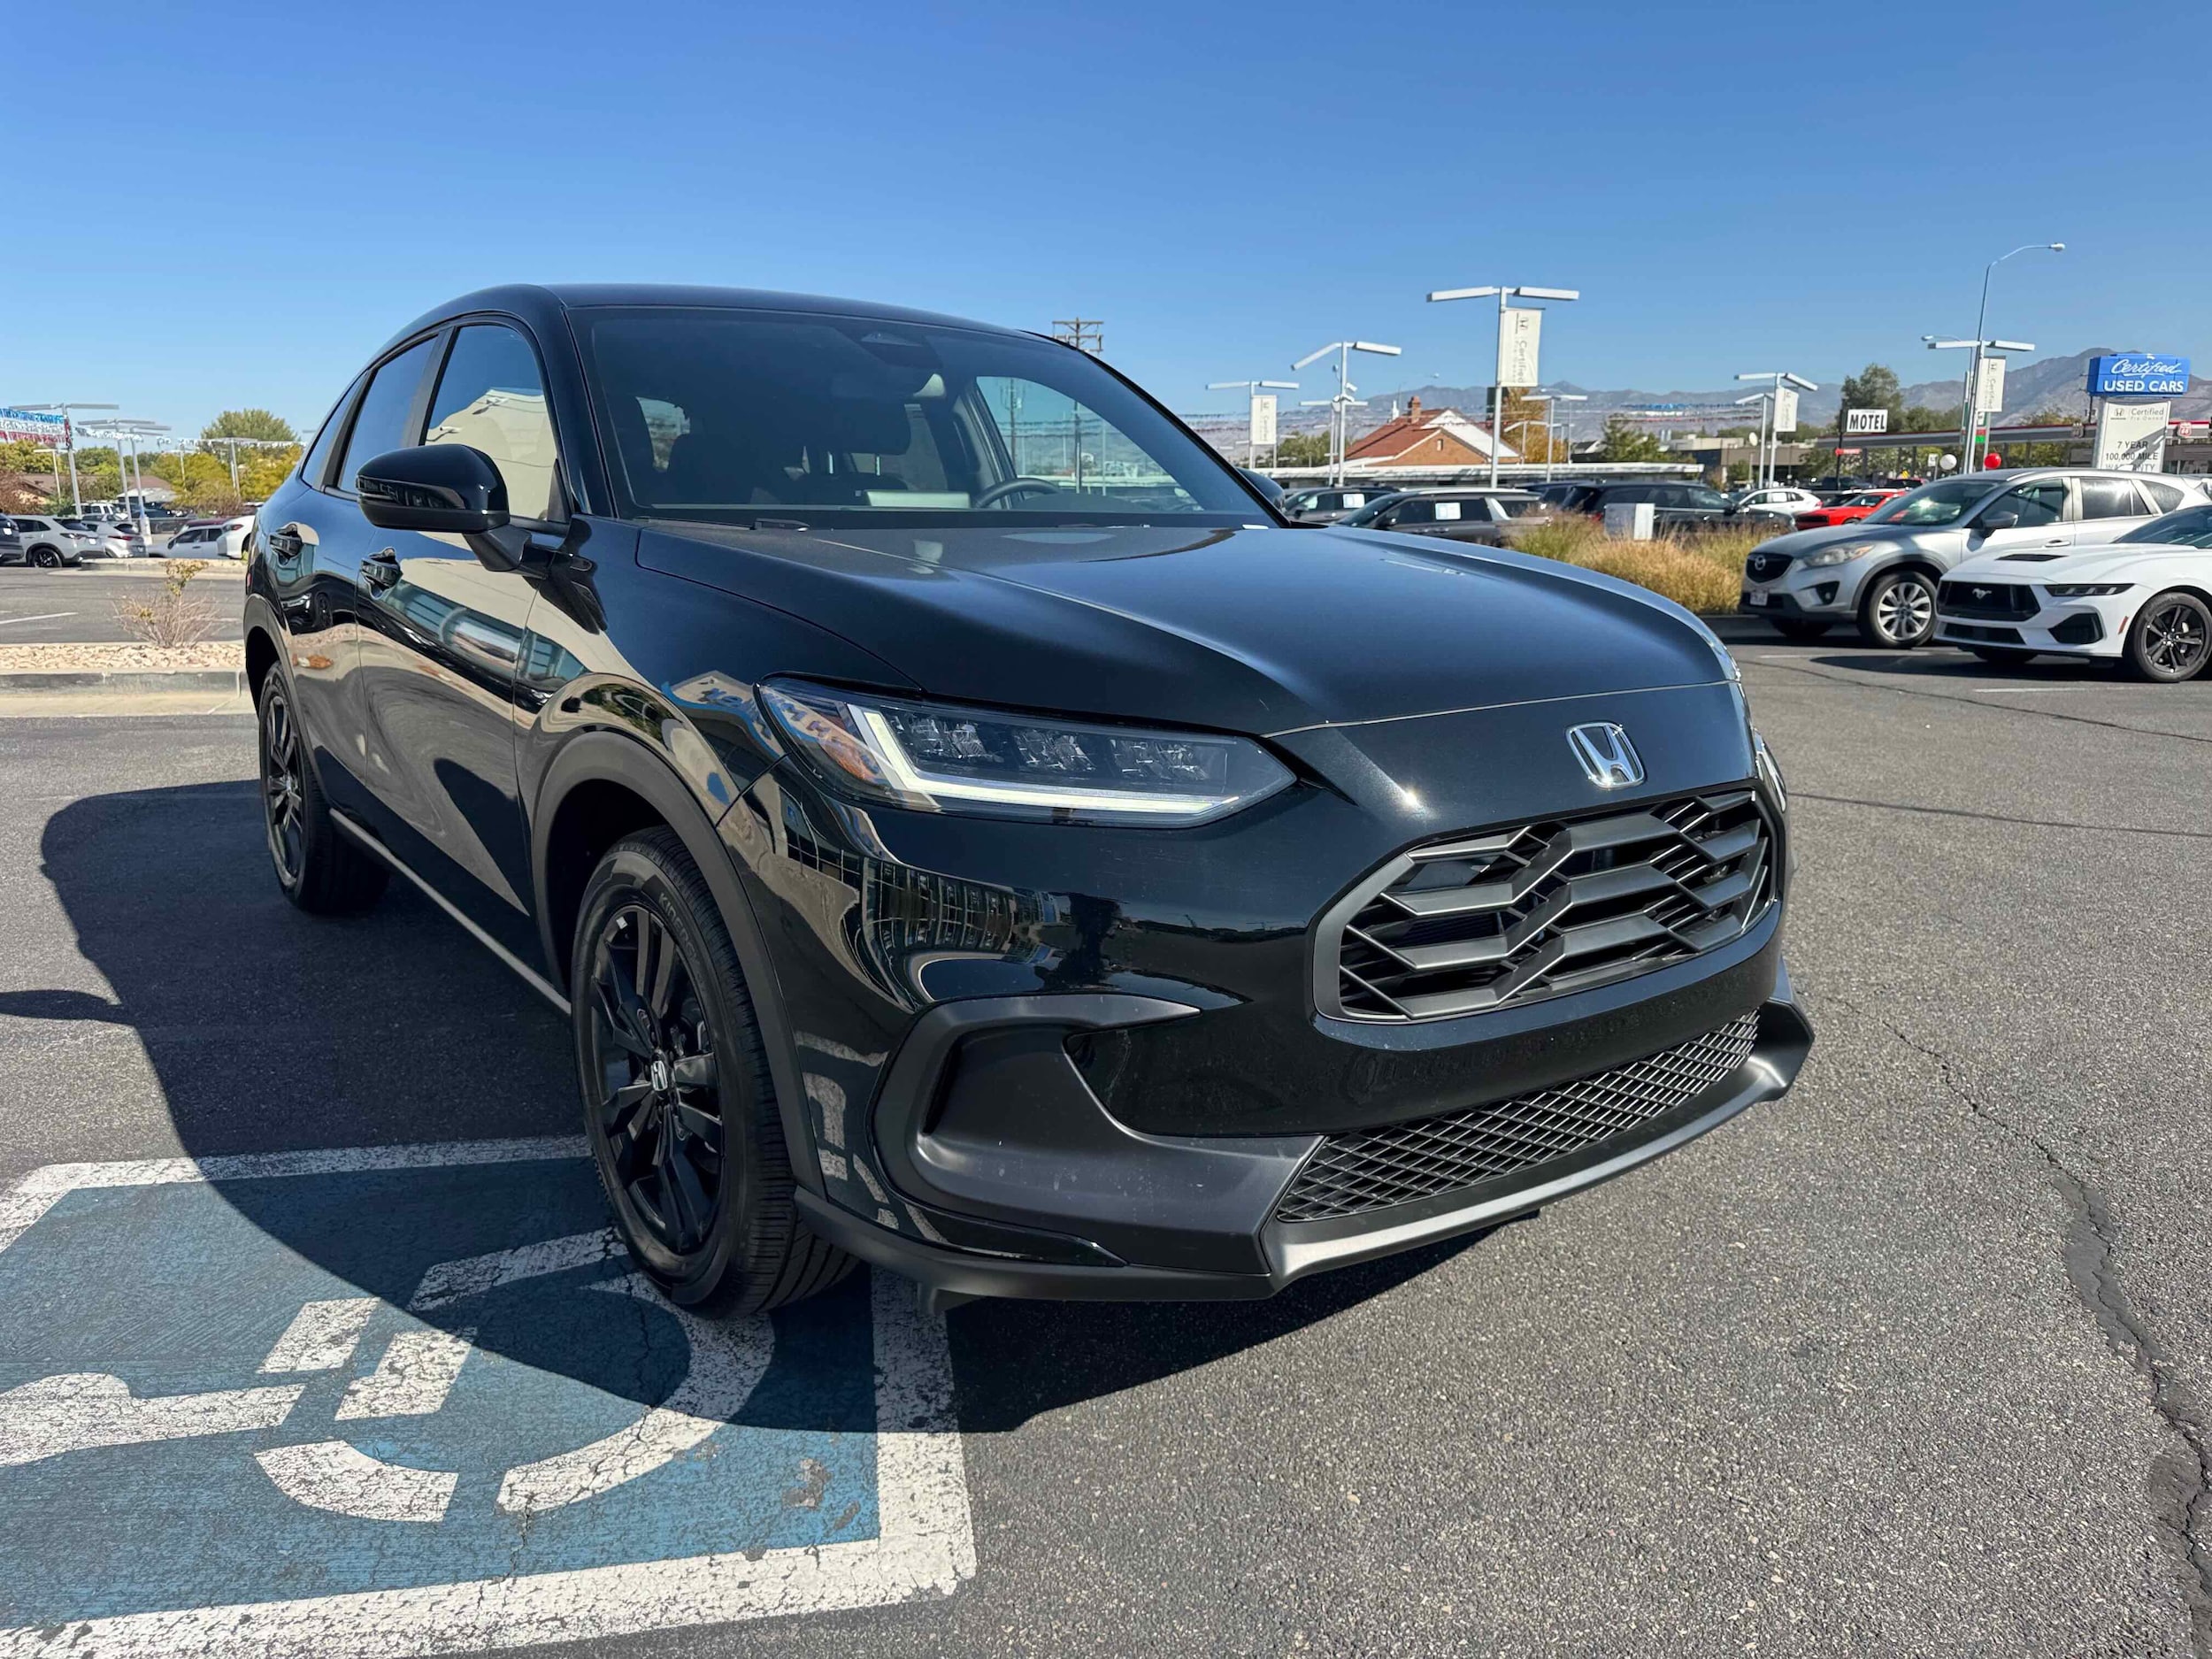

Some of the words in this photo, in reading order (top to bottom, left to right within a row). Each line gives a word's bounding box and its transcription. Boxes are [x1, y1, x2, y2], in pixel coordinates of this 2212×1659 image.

[2111, 358, 2182, 378] Certified
[2103, 380, 2146, 392] USED
[2148, 380, 2185, 392] CARS
[2131, 407, 2164, 416] Certified
[1849, 414, 1886, 430] MOTEL
[2116, 441, 2123, 449] 7
[2124, 441, 2148, 449] YEAR
[2106, 452, 2136, 462] 100,000
